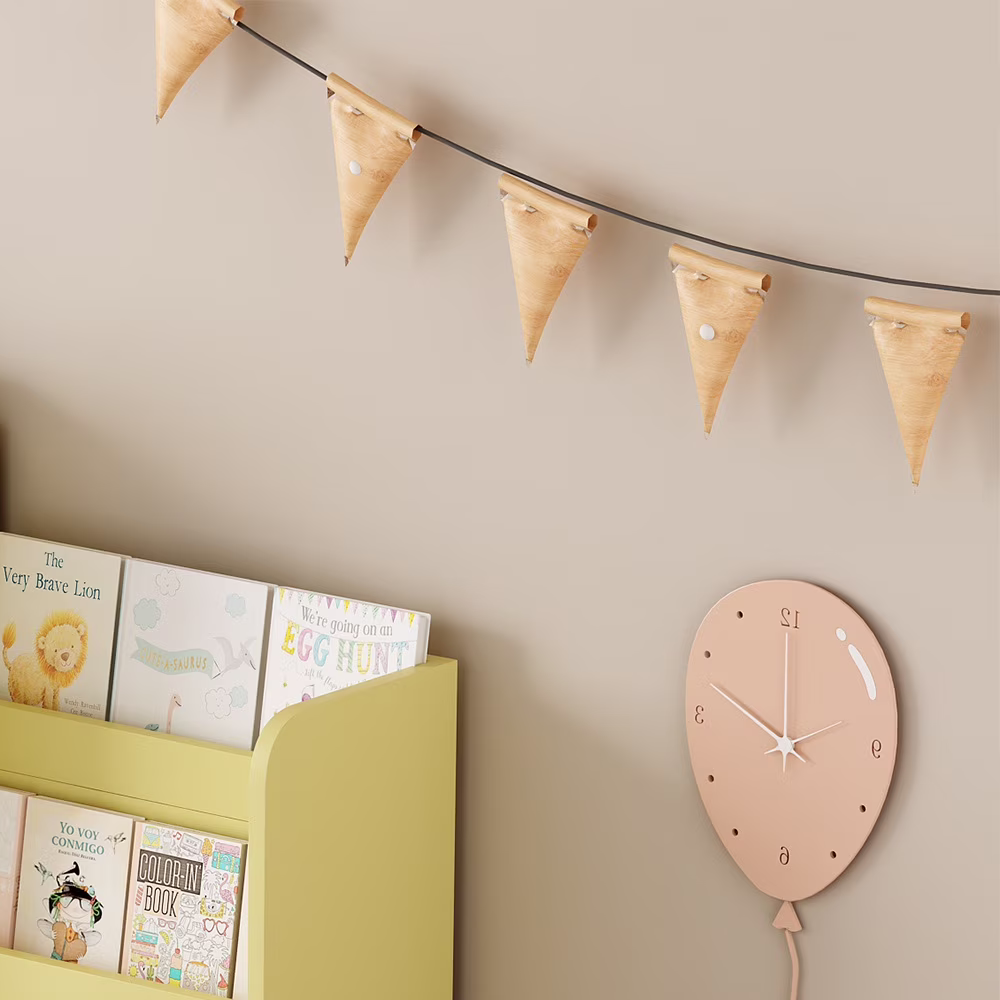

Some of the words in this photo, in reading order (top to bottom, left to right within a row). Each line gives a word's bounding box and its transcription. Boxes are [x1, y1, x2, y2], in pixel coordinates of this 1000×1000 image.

[44, 552, 64, 568] The
[3, 566, 30, 592] Very
[36, 573, 69, 593] Brave
[74, 580, 101, 600] Lion
[301, 605, 328, 627] We're
[330, 619, 360, 638] going
[363, 625, 377, 636] on
[380, 626, 393, 636] an
[281, 620, 330, 667] EGG
[336, 639, 409, 675] HUNT
[52, 836, 104, 855] CONMIGO
[60, 821, 75, 835] YO
[78, 828, 99, 840] VOY
[144, 885, 179, 917] BOOK
